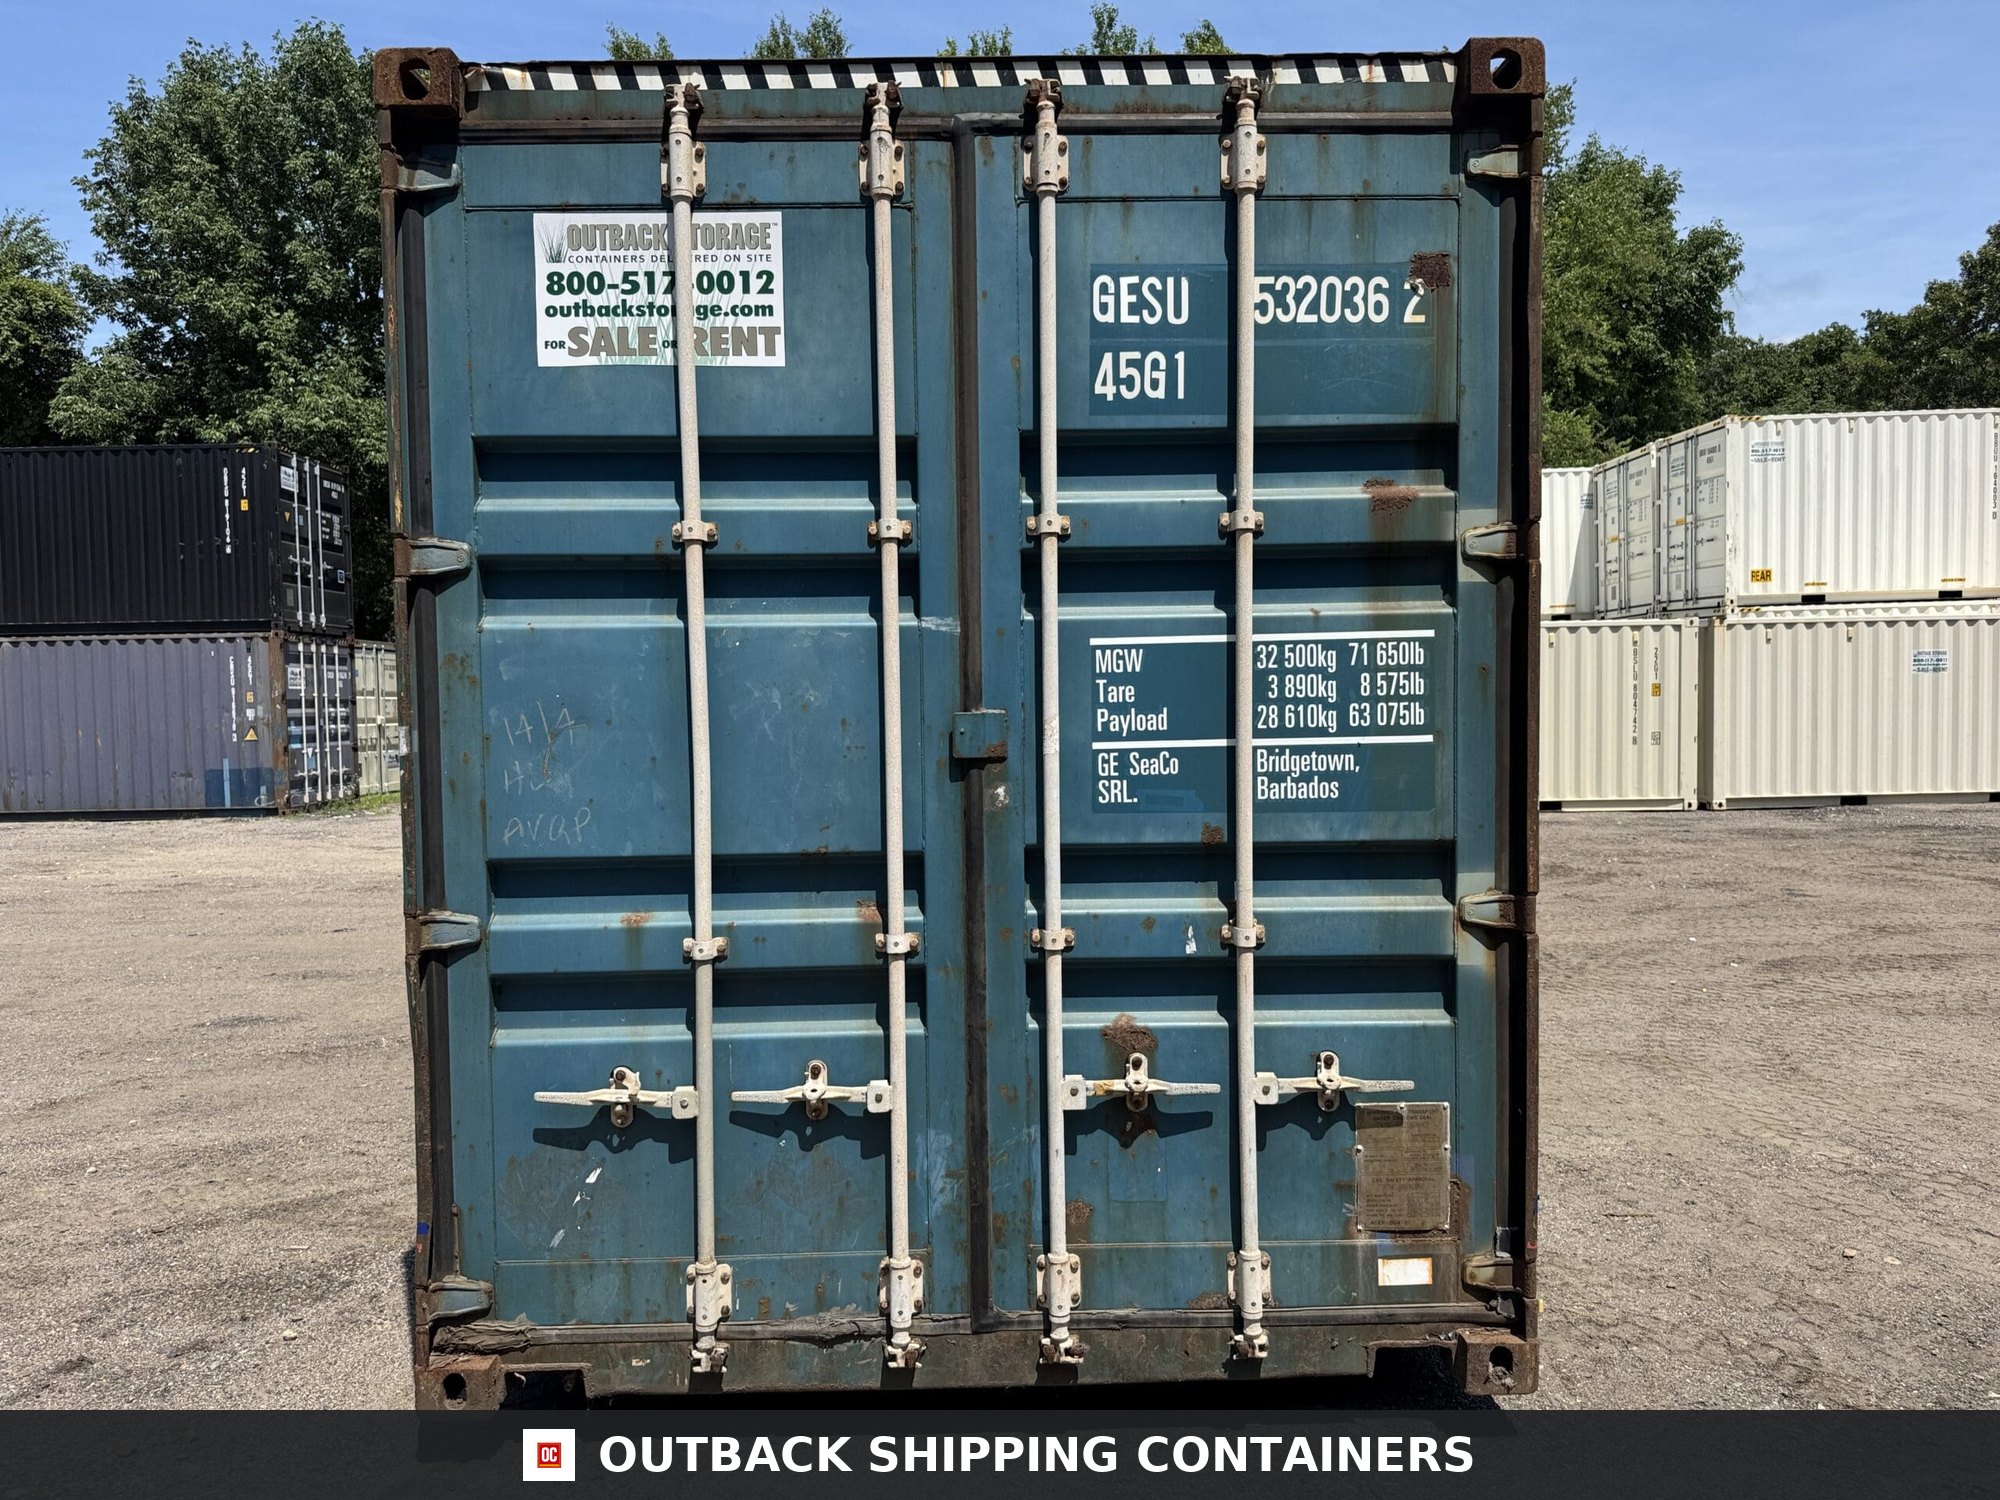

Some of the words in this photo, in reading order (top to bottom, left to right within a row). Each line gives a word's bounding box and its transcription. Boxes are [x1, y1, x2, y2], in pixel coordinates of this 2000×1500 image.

[566, 223, 670, 251] OUTBACK
[691, 222, 771, 250] TORAGE
[568, 254, 645, 264] CONTAINERS
[651, 254, 718, 264] DELRED
[724, 254, 741, 263] ON
[747, 253, 772, 263] SITE
[546, 270, 774, 295] 800-5170012
[544, 299, 774, 321] outbackstorge.com
[1092, 274, 1190, 325] GESU
[1253, 275, 1390, 325] 532036
[1402, 278, 1426, 324] 2
[544, 340, 566, 350] FOR
[567, 326, 658, 357] SALE
[692, 326, 781, 357] RENT
[1093, 350, 1186, 402] 45G1
[1751, 569, 1772, 583] REAR
[1095, 649, 1144, 673] MGW
[1256, 644, 1278, 669] 32
[1284, 643, 1338, 672] 500kg
[1348, 642, 1369, 666] 71
[1376, 641, 1425, 666] 650lb
[1095, 679, 1136, 703] Tare
[1268, 675, 1279, 699] 3
[1284, 673, 1338, 702] 890kg
[1360, 672, 1371, 697] 8
[1376, 671, 1425, 696] 575lb
[1096, 707, 1169, 737] Payload
[1256, 705, 1279, 729] 28
[1284, 704, 1338, 732] 610kg
[1348, 703, 1371, 727] 63
[1376, 702, 1425, 727] 075lb
[1097, 753, 1119, 777] GE
[1129, 751, 1180, 776] SeaCo
[1256, 749, 1360, 778] Bridgetown,
[1097, 779, 1138, 803] SRL.
[1256, 775, 1339, 800] Barbados
